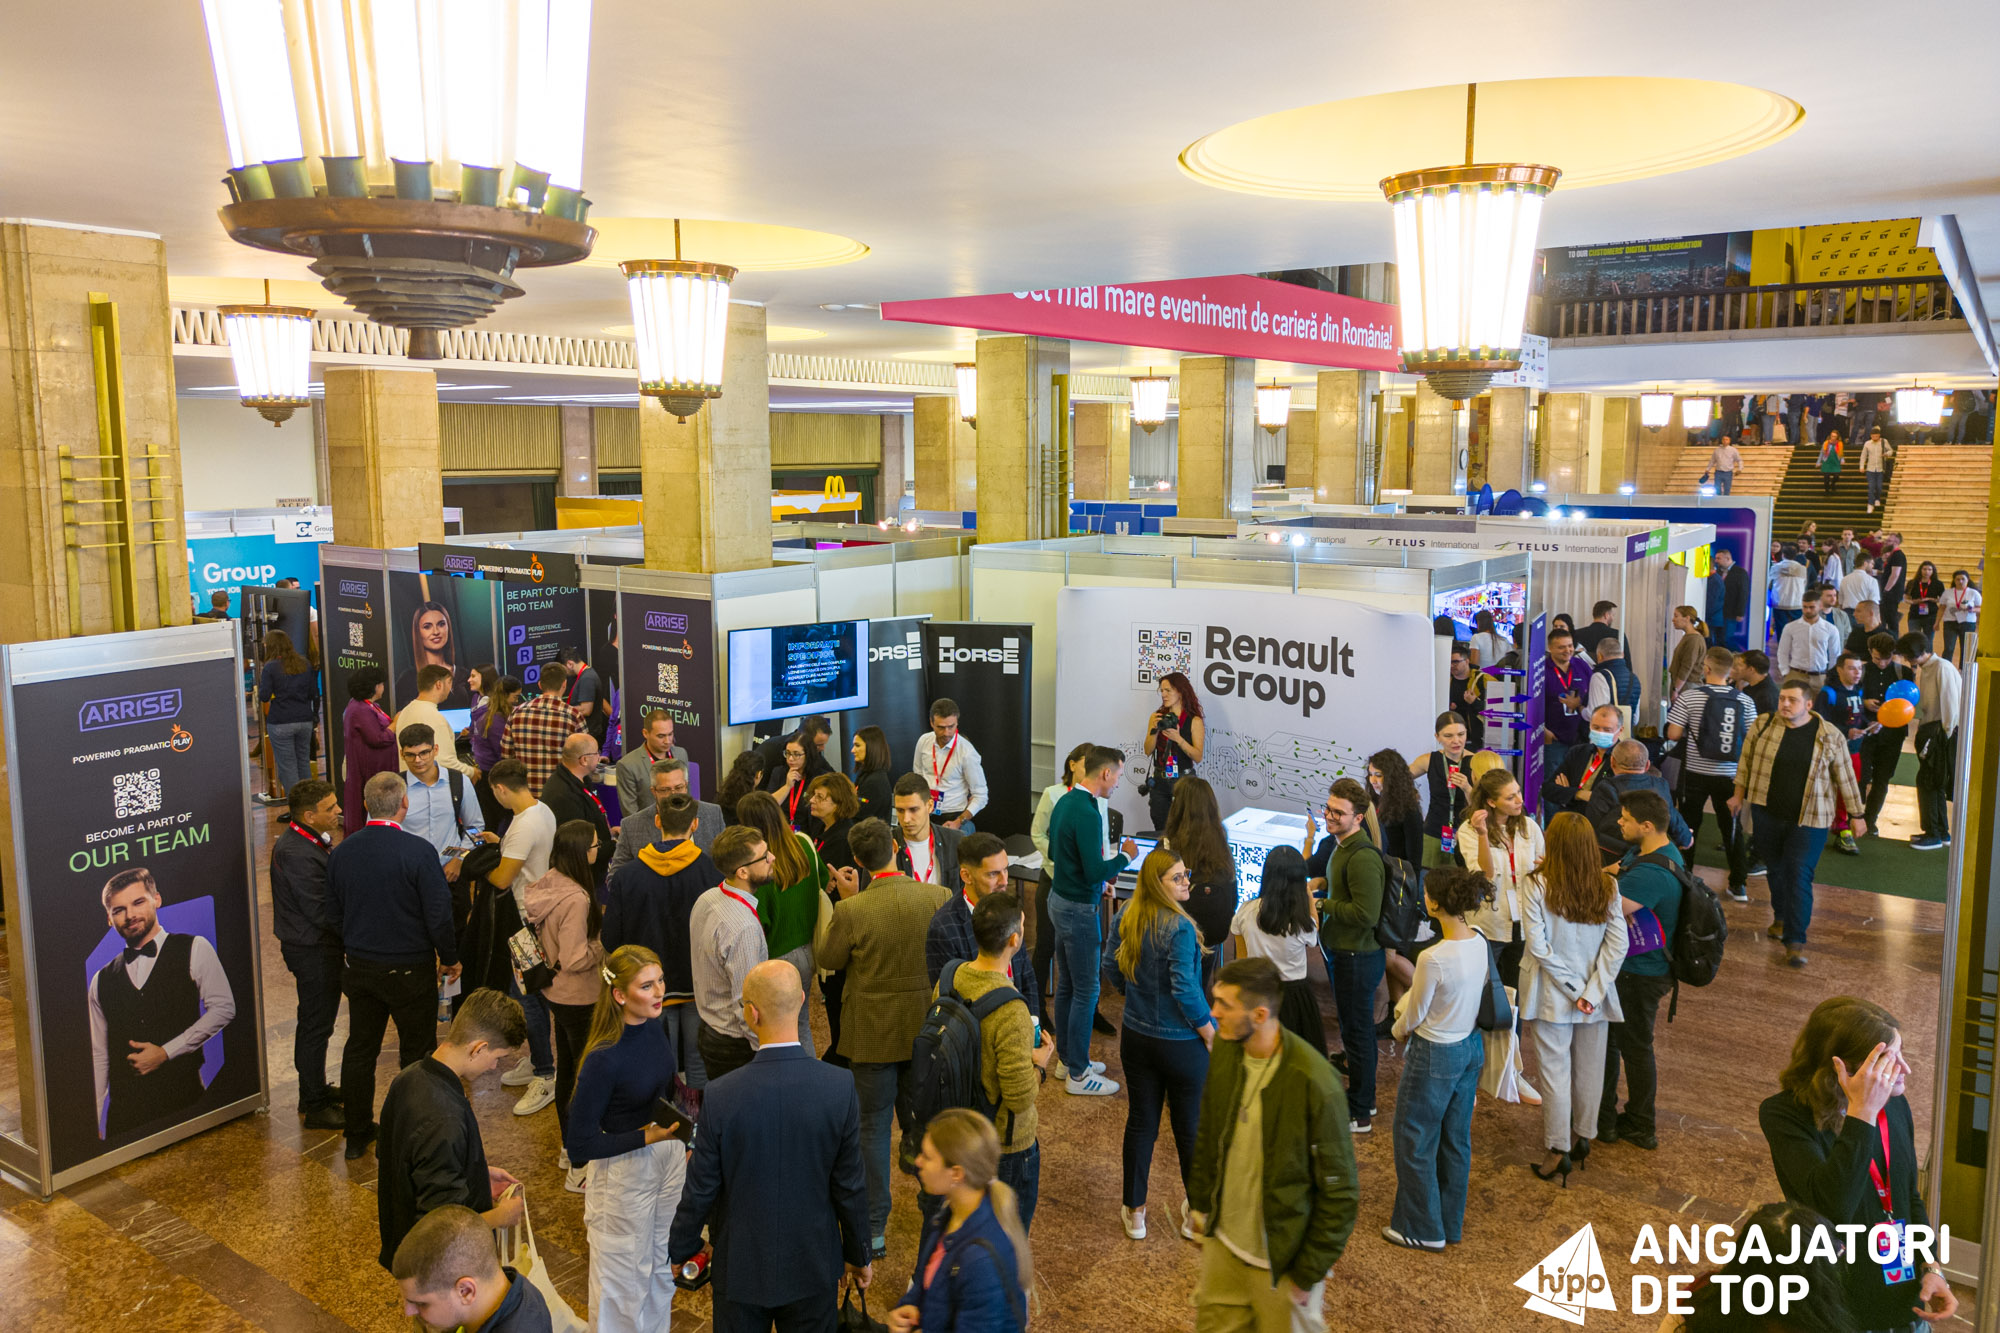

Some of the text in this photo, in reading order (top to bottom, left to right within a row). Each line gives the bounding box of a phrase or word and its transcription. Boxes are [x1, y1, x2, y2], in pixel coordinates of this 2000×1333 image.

[1105, 286, 1155, 318] mare
[1160, 294, 1247, 331] eveniment
[1251, 301, 1269, 333] de
[1272, 310, 1317, 340] carieră
[1321, 313, 1339, 343] din
[1342, 317, 1392, 350] România!
[1311, 536, 1346, 545] ernational
[1388, 538, 1480, 550] TELUS International
[1518, 543, 1618, 554] TELUS International
[446, 558, 474, 570] ARRISE
[203, 563, 276, 584] Group
[342, 582, 366, 594] ARRISE
[506, 591, 518, 600] BE
[521, 588, 542, 598] PART
[546, 586, 558, 596] OF
[508, 600, 554, 612] PRO TEAM
[647, 614, 685, 630] ARRISE
[869, 644, 922, 662] ORSE
[939, 648, 1019, 662] HORSE
[1158, 654, 1172, 662] RG
[1205, 626, 1354, 678] Renault
[338, 656, 354, 669] OUR
[1204, 662, 1326, 718] Group
[85, 694, 176, 725] ARRISE
[667, 708, 700, 727] TEAM
[1720, 708, 1735, 754] adidas
[72, 737, 190, 764] POWERING PRAGMATIC PLAY
[86, 812, 192, 843] BECOME A PART OF
[69, 824, 210, 872] OUR TEAM
